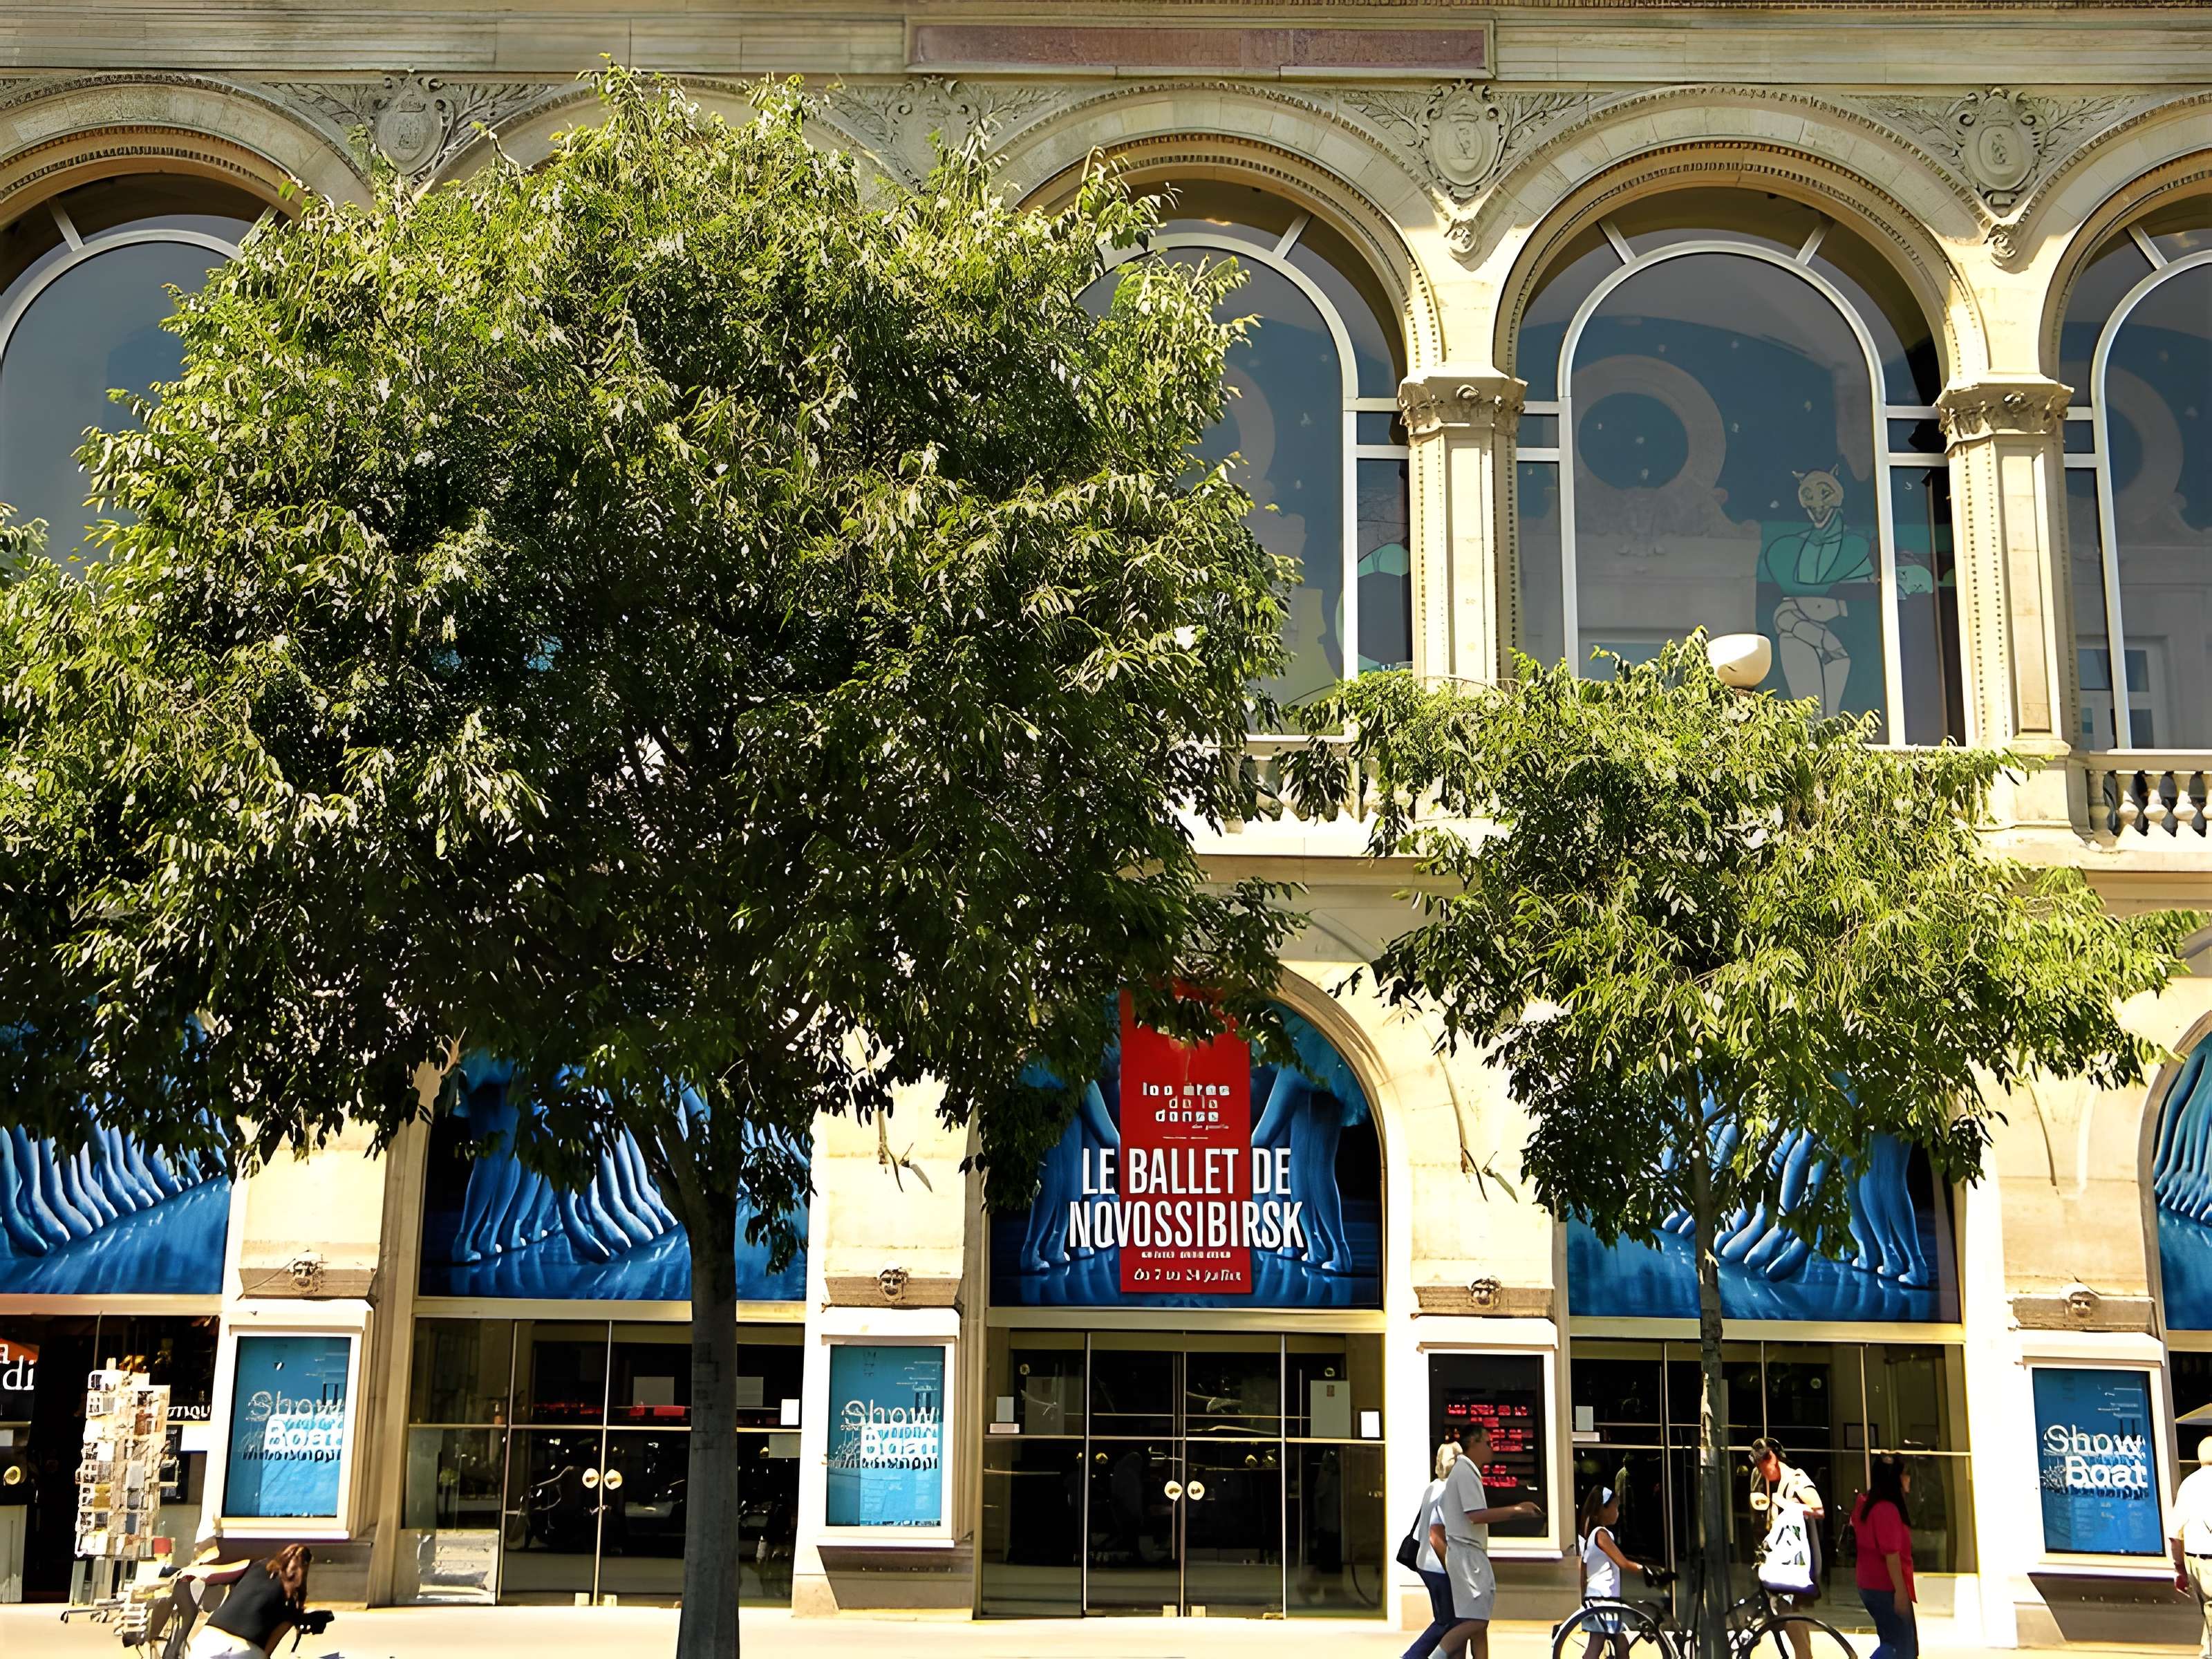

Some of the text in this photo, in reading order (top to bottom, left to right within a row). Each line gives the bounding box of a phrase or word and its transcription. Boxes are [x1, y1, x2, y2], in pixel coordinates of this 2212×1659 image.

[1082, 1147, 1292, 1194] LE BALLET DE
[1069, 1200, 1304, 1248] NOVOSSIBIRSK
[245, 1390, 344, 1421] Show
[841, 1398, 939, 1427] Show
[263, 1416, 343, 1450] Boat
[2044, 1424, 2146, 1457] Show
[2065, 1455, 2148, 1489] Boat
